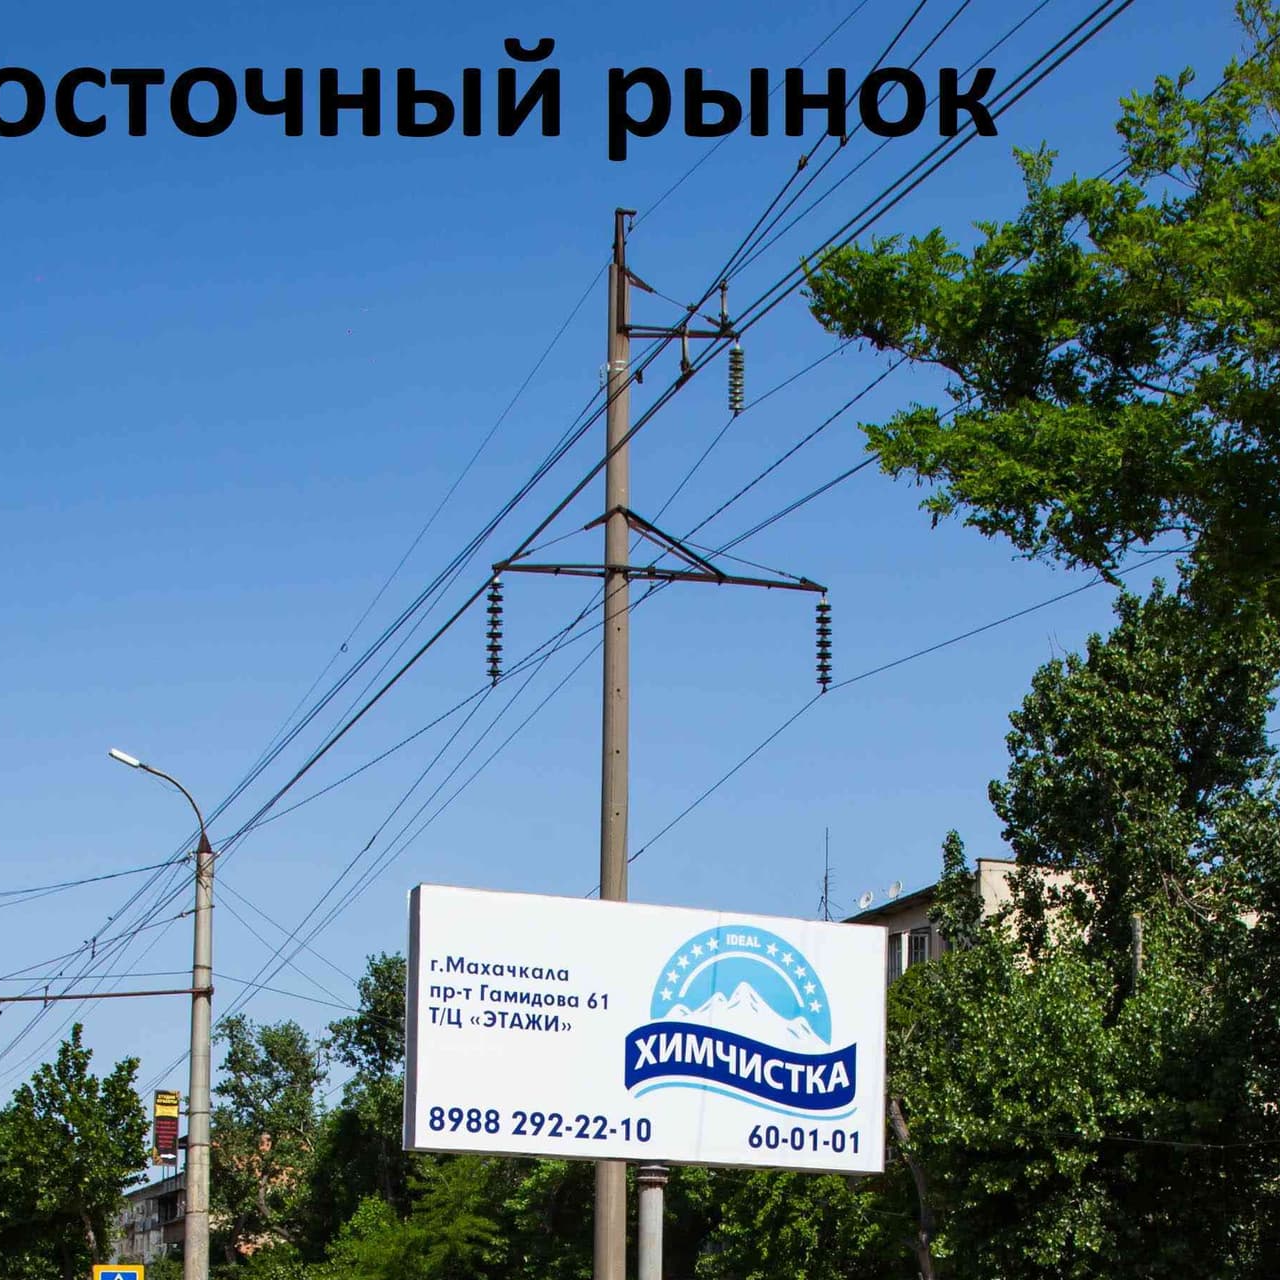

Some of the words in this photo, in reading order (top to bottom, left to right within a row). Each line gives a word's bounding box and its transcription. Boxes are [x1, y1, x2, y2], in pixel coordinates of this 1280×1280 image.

[726, 934, 761, 948] IDEAL
[430, 956, 569, 981] г.Махачкала
[430, 985, 472, 1002] пр-т
[480, 984, 579, 1008] Гамидова
[587, 992, 608, 1010] 61
[429, 1007, 462, 1028] Т/Ц
[470, 1010, 571, 1032] «ЭТАЖИ»
[634, 1032, 850, 1094] ХИМЧИСТКА
[429, 1106, 500, 1134] 8988
[511, 1111, 651, 1142] 292-22-10
[748, 1125, 859, 1154] 60-01-01
